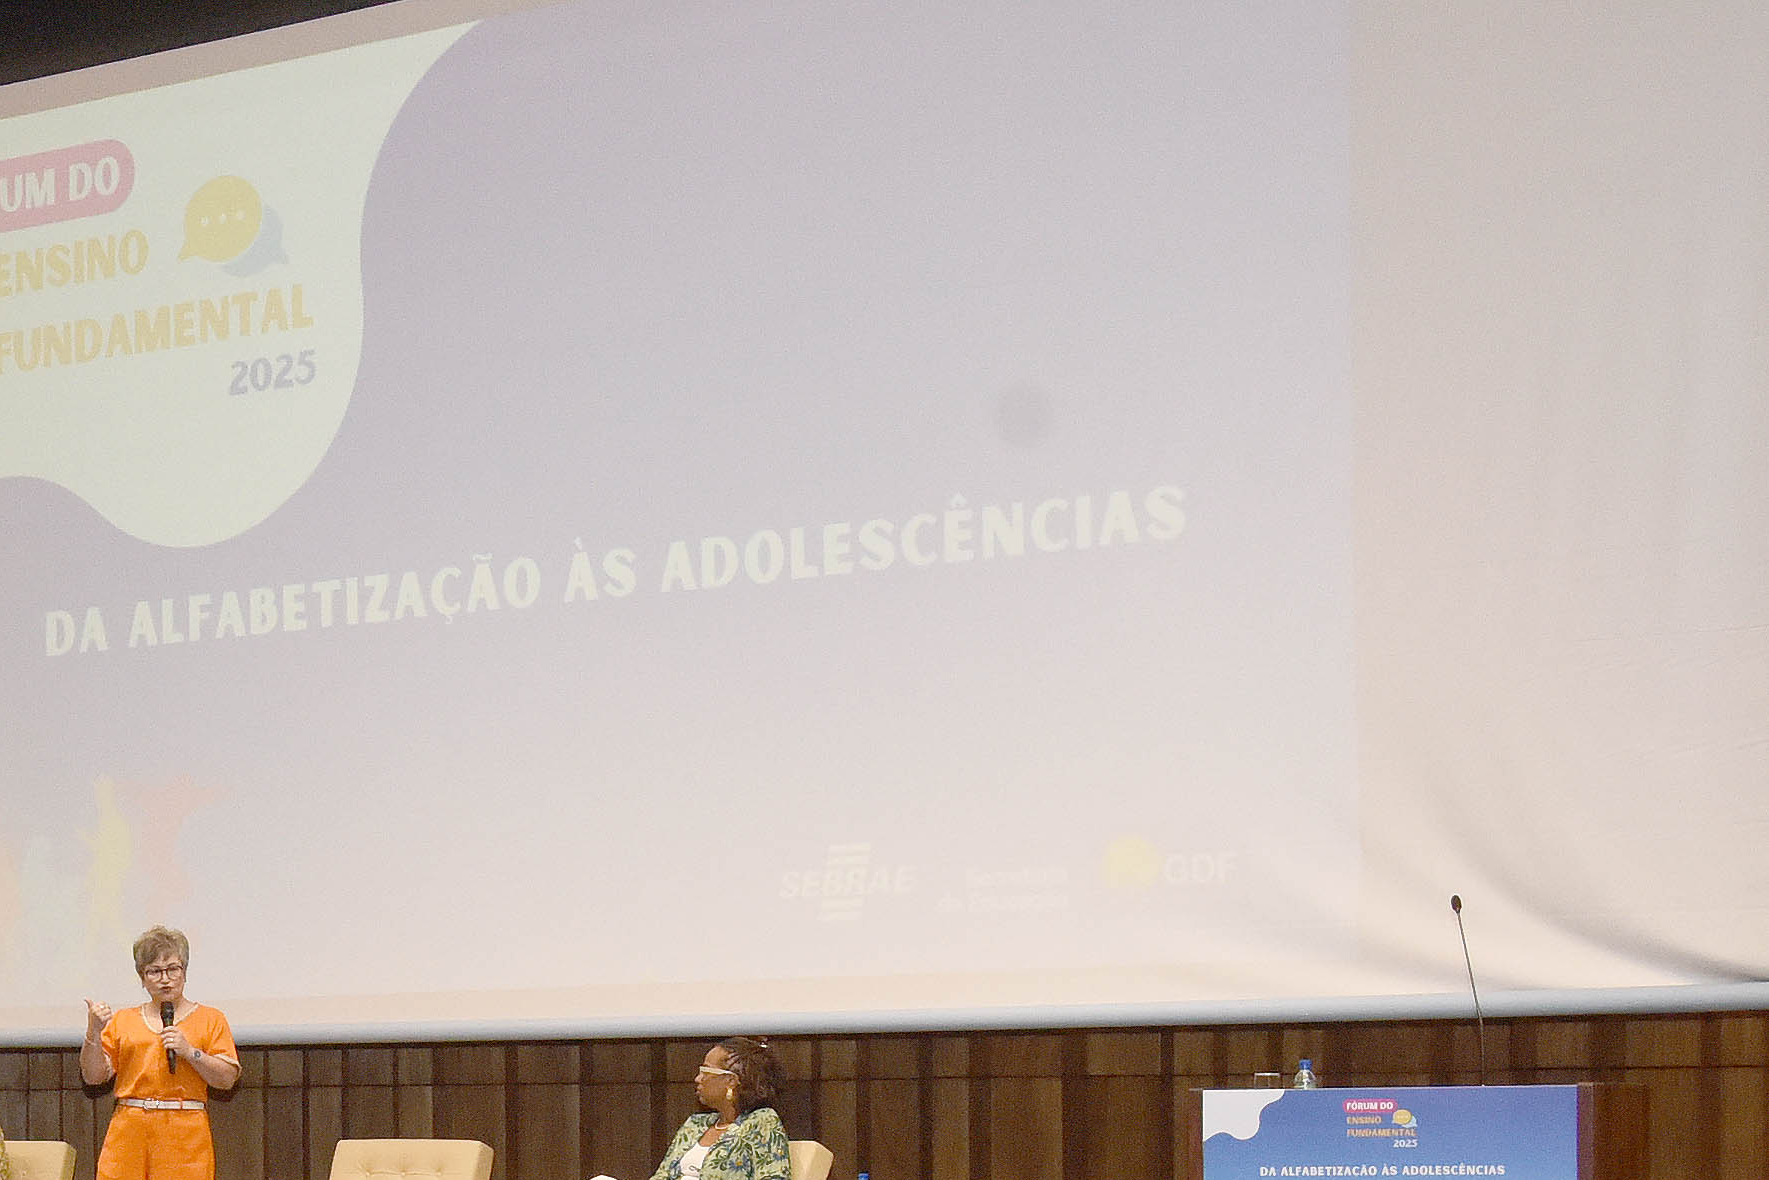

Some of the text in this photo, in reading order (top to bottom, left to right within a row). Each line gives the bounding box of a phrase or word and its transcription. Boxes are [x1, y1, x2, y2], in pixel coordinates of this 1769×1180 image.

[68, 155, 121, 201] DO
[228, 349, 317, 397] 2025
[44, 485, 1187, 657] DA ALFABETIZAÇÃO ÀS ADOLESCÊNCIAS
[1380, 1102, 1394, 1110] DO
[1393, 1139, 1418, 1148] 2025
[1259, 1163, 1506, 1177] DA ALFABETIZAÇÃO ÀS ADOLESCÊNCIAS
